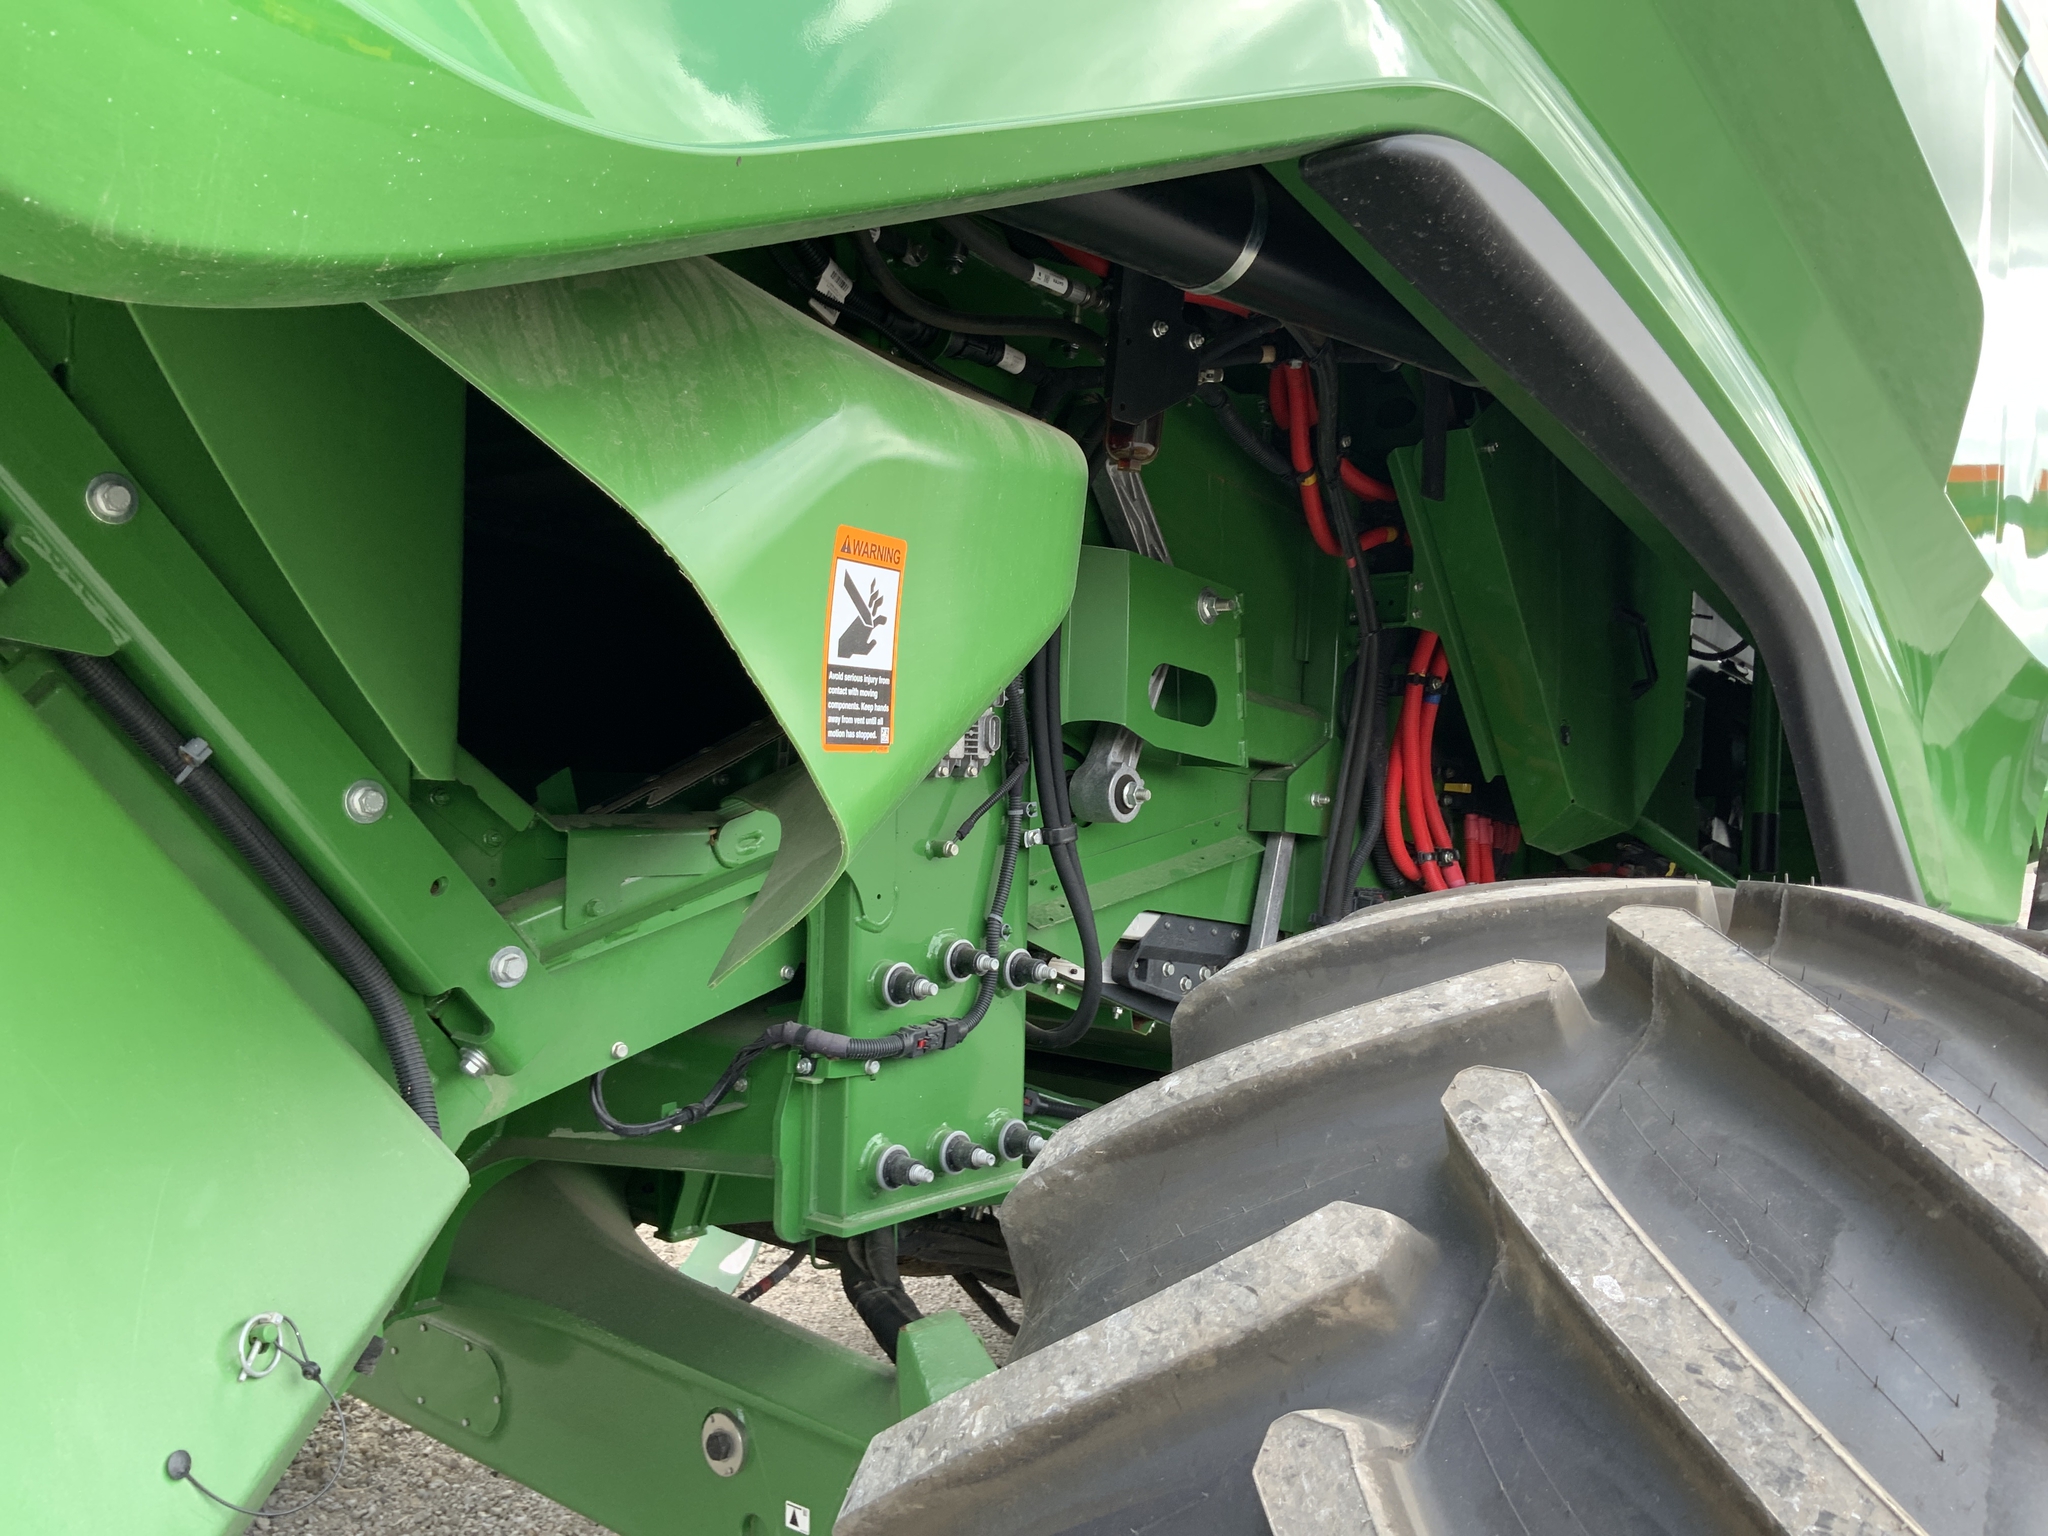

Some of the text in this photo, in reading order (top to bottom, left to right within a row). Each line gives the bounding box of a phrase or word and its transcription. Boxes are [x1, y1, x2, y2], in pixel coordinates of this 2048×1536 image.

[853, 539, 901, 565] WARNING
[829, 671, 890, 686] Avoid serious injury from
[828, 686, 878, 700] contact with moving
[828, 701, 889, 713] components. Keep hands
[828, 715, 841, 726] away
[841, 715, 853, 724] from
[854, 717, 865, 725] vent
[865, 716, 877, 725] until
[828, 729, 877, 741] motion has stopped.
